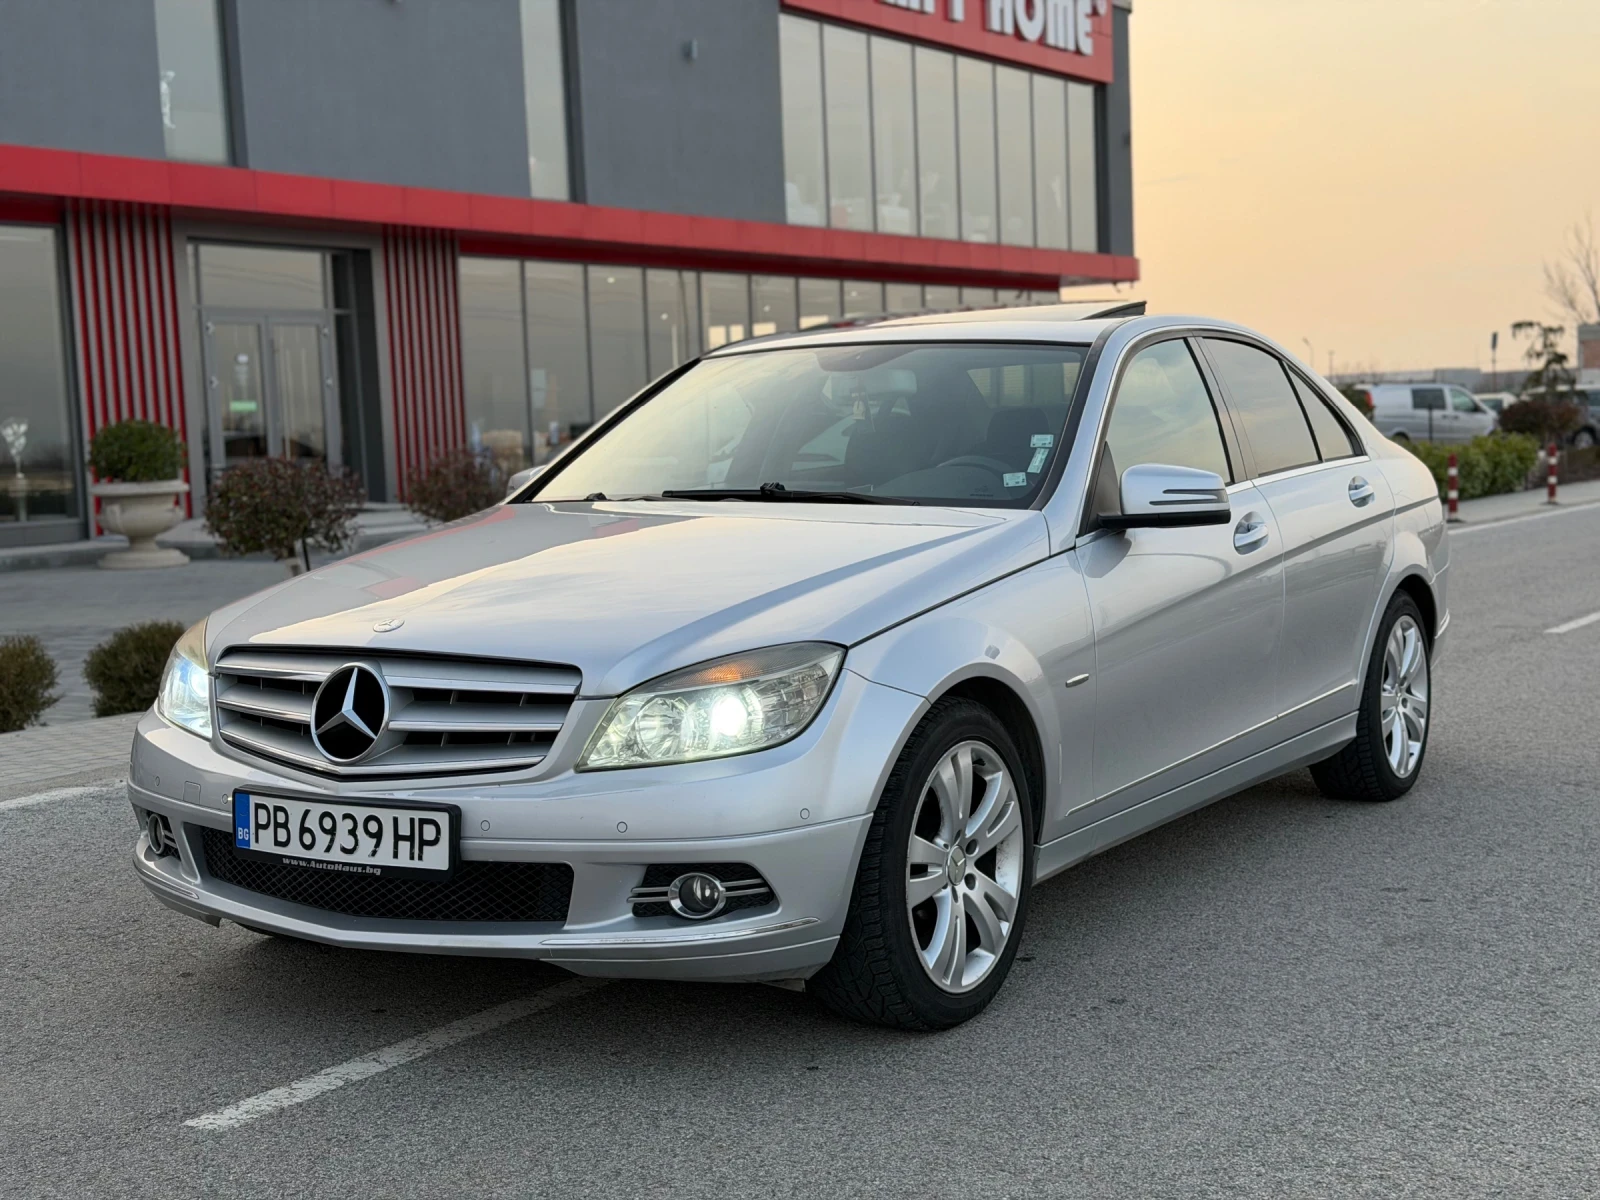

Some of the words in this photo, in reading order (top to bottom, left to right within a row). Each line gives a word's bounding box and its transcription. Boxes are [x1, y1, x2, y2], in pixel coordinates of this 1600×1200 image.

[237, 827, 249, 841] BG
[254, 802, 291, 848] PB
[299, 809, 383, 858] 6939
[393, 816, 441, 861] HP
[282, 858, 382, 875] www.AutoHaus.bg
